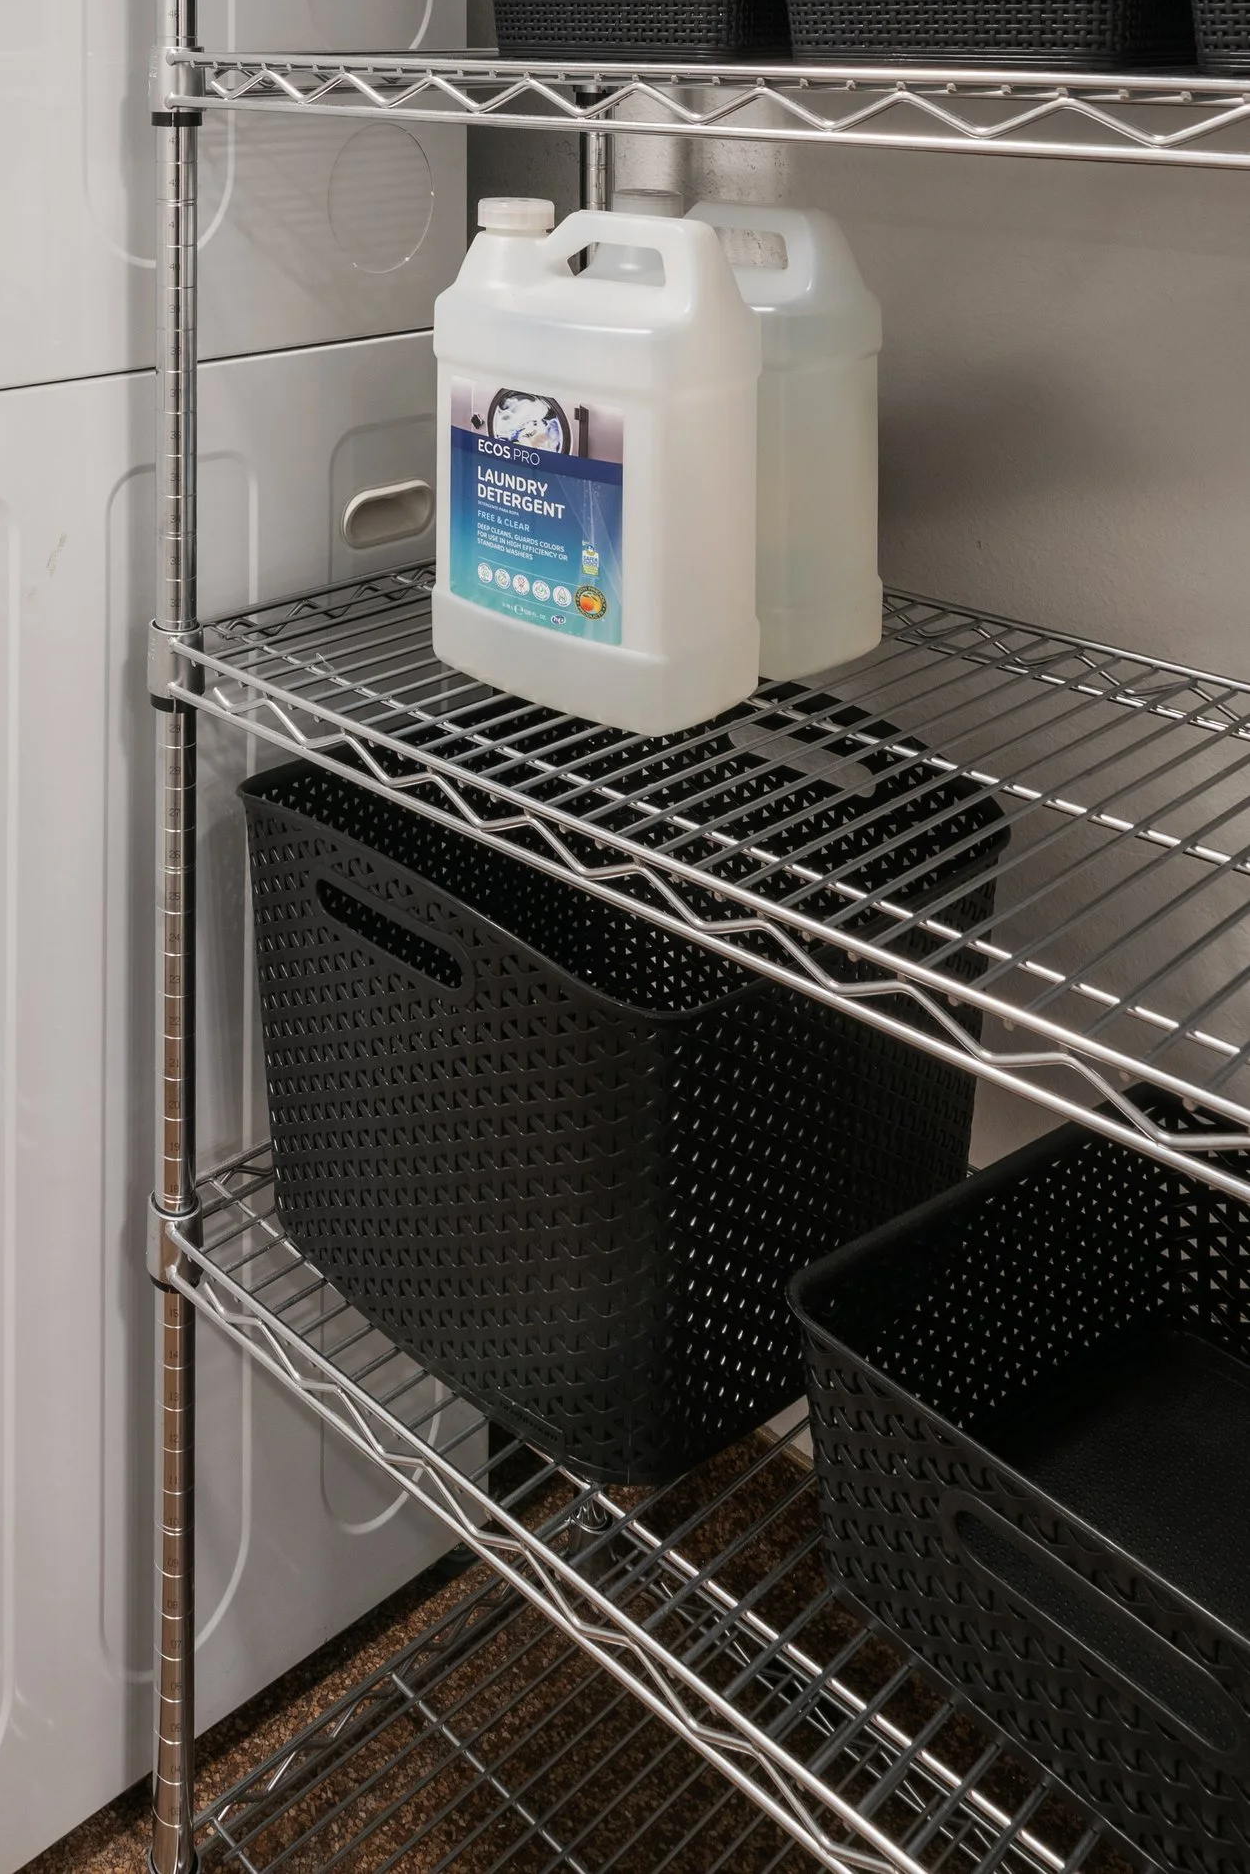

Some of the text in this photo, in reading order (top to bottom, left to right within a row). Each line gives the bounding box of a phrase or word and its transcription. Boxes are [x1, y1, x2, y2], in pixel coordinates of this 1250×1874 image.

[478, 439, 540, 465] ECOS PRO
[478, 466, 548, 497] LAUNDRY
[478, 484, 565, 519] DETERGENT
[478, 510, 530, 532] FREE & CLEAR
[477, 522, 490, 531] DEEP
[514, 534, 538, 546] GUARDS
[539, 541, 565, 552] COLORS
[477, 530, 488, 538] FOR
[488, 534, 498, 542] USE
[507, 539, 521, 549] HIGH
[522, 545, 557, 559] EFFICIENCY
[477, 537, 533, 560] STANDARD WASHERS
[170, 808, 181, 816] 27
[169, 850, 180, 859] 26
[169, 892, 180, 901] 25
[170, 933, 181, 942] 24
[170, 975, 181, 984] 23
[170, 1017, 181, 1026] 22
[170, 1059, 180, 1068] 21
[170, 1142, 179, 1151] 19
